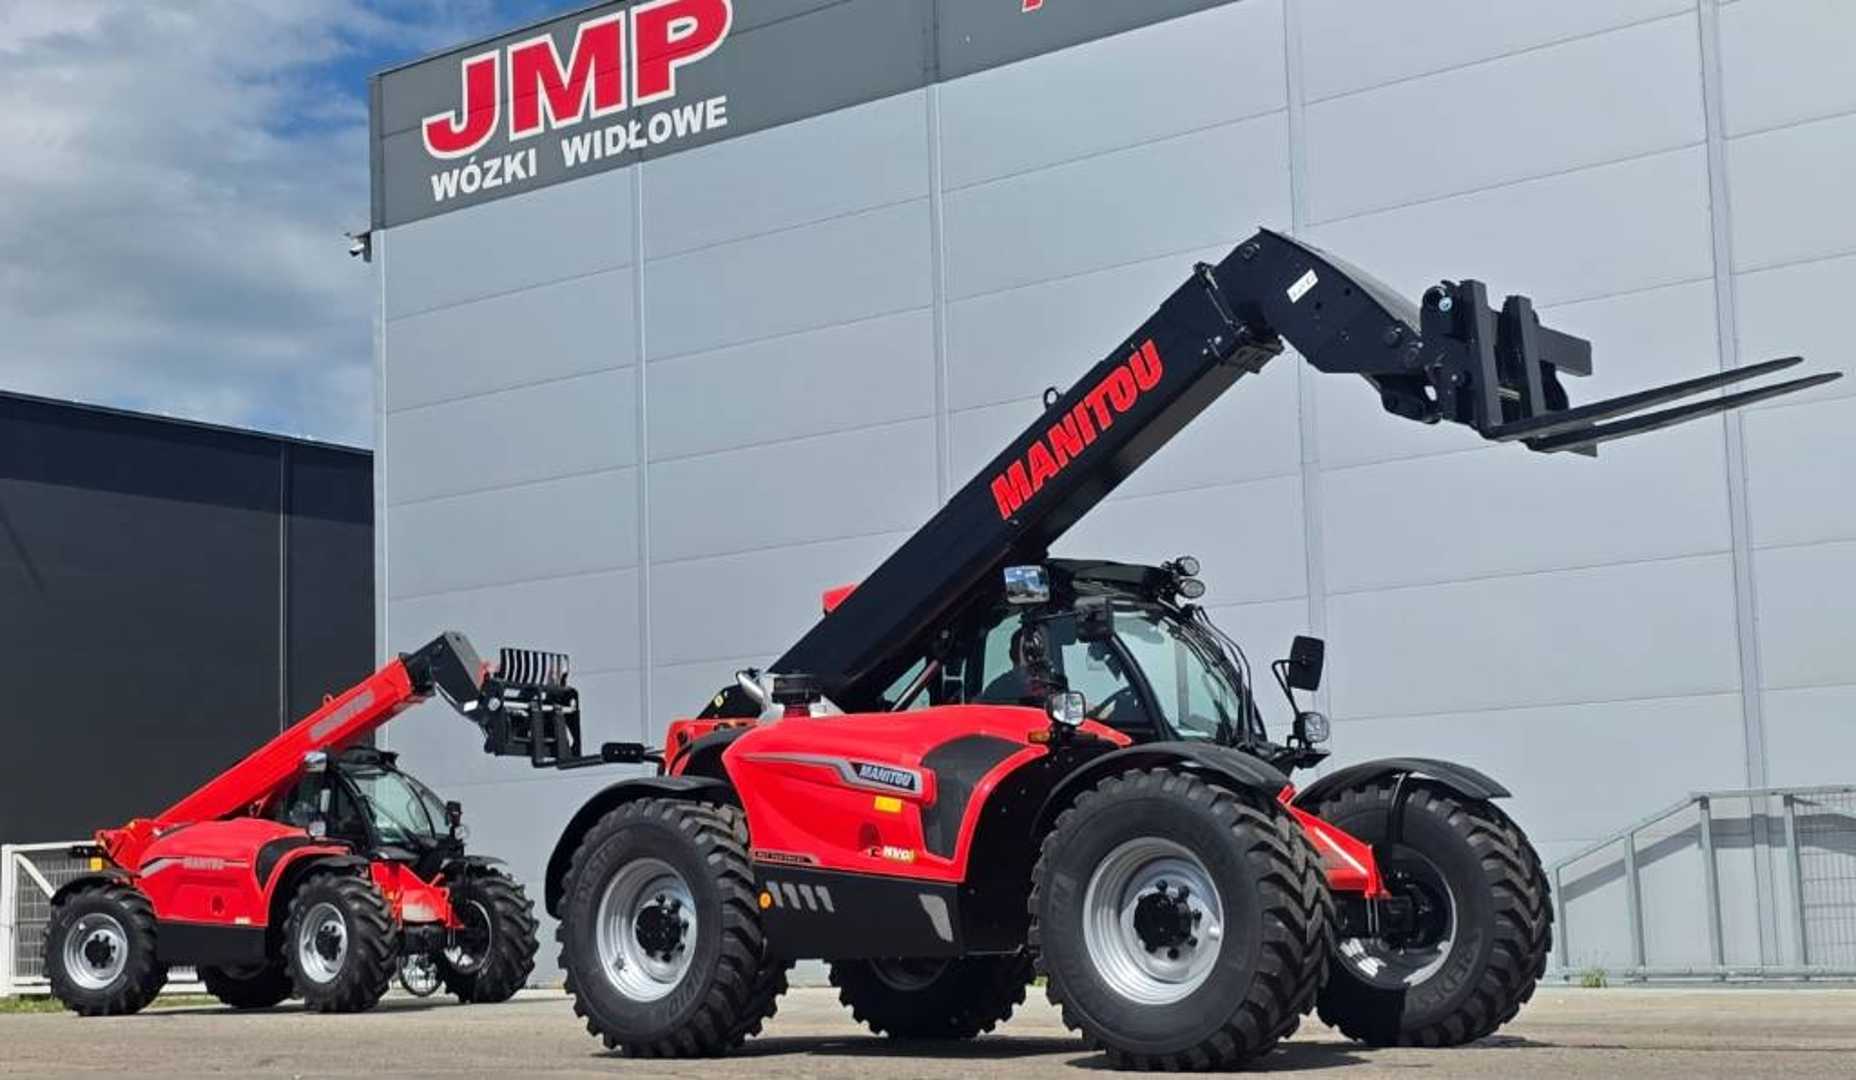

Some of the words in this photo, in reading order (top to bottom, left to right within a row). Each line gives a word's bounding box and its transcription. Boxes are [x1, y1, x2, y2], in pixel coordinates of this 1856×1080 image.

[422, 0, 733, 159] JMP
[431, 149, 537, 201] WÓZKI
[561, 96, 728, 167] WIDŁOWE
[990, 338, 1163, 520] MANITOU
[859, 765, 912, 786] MANITOU
